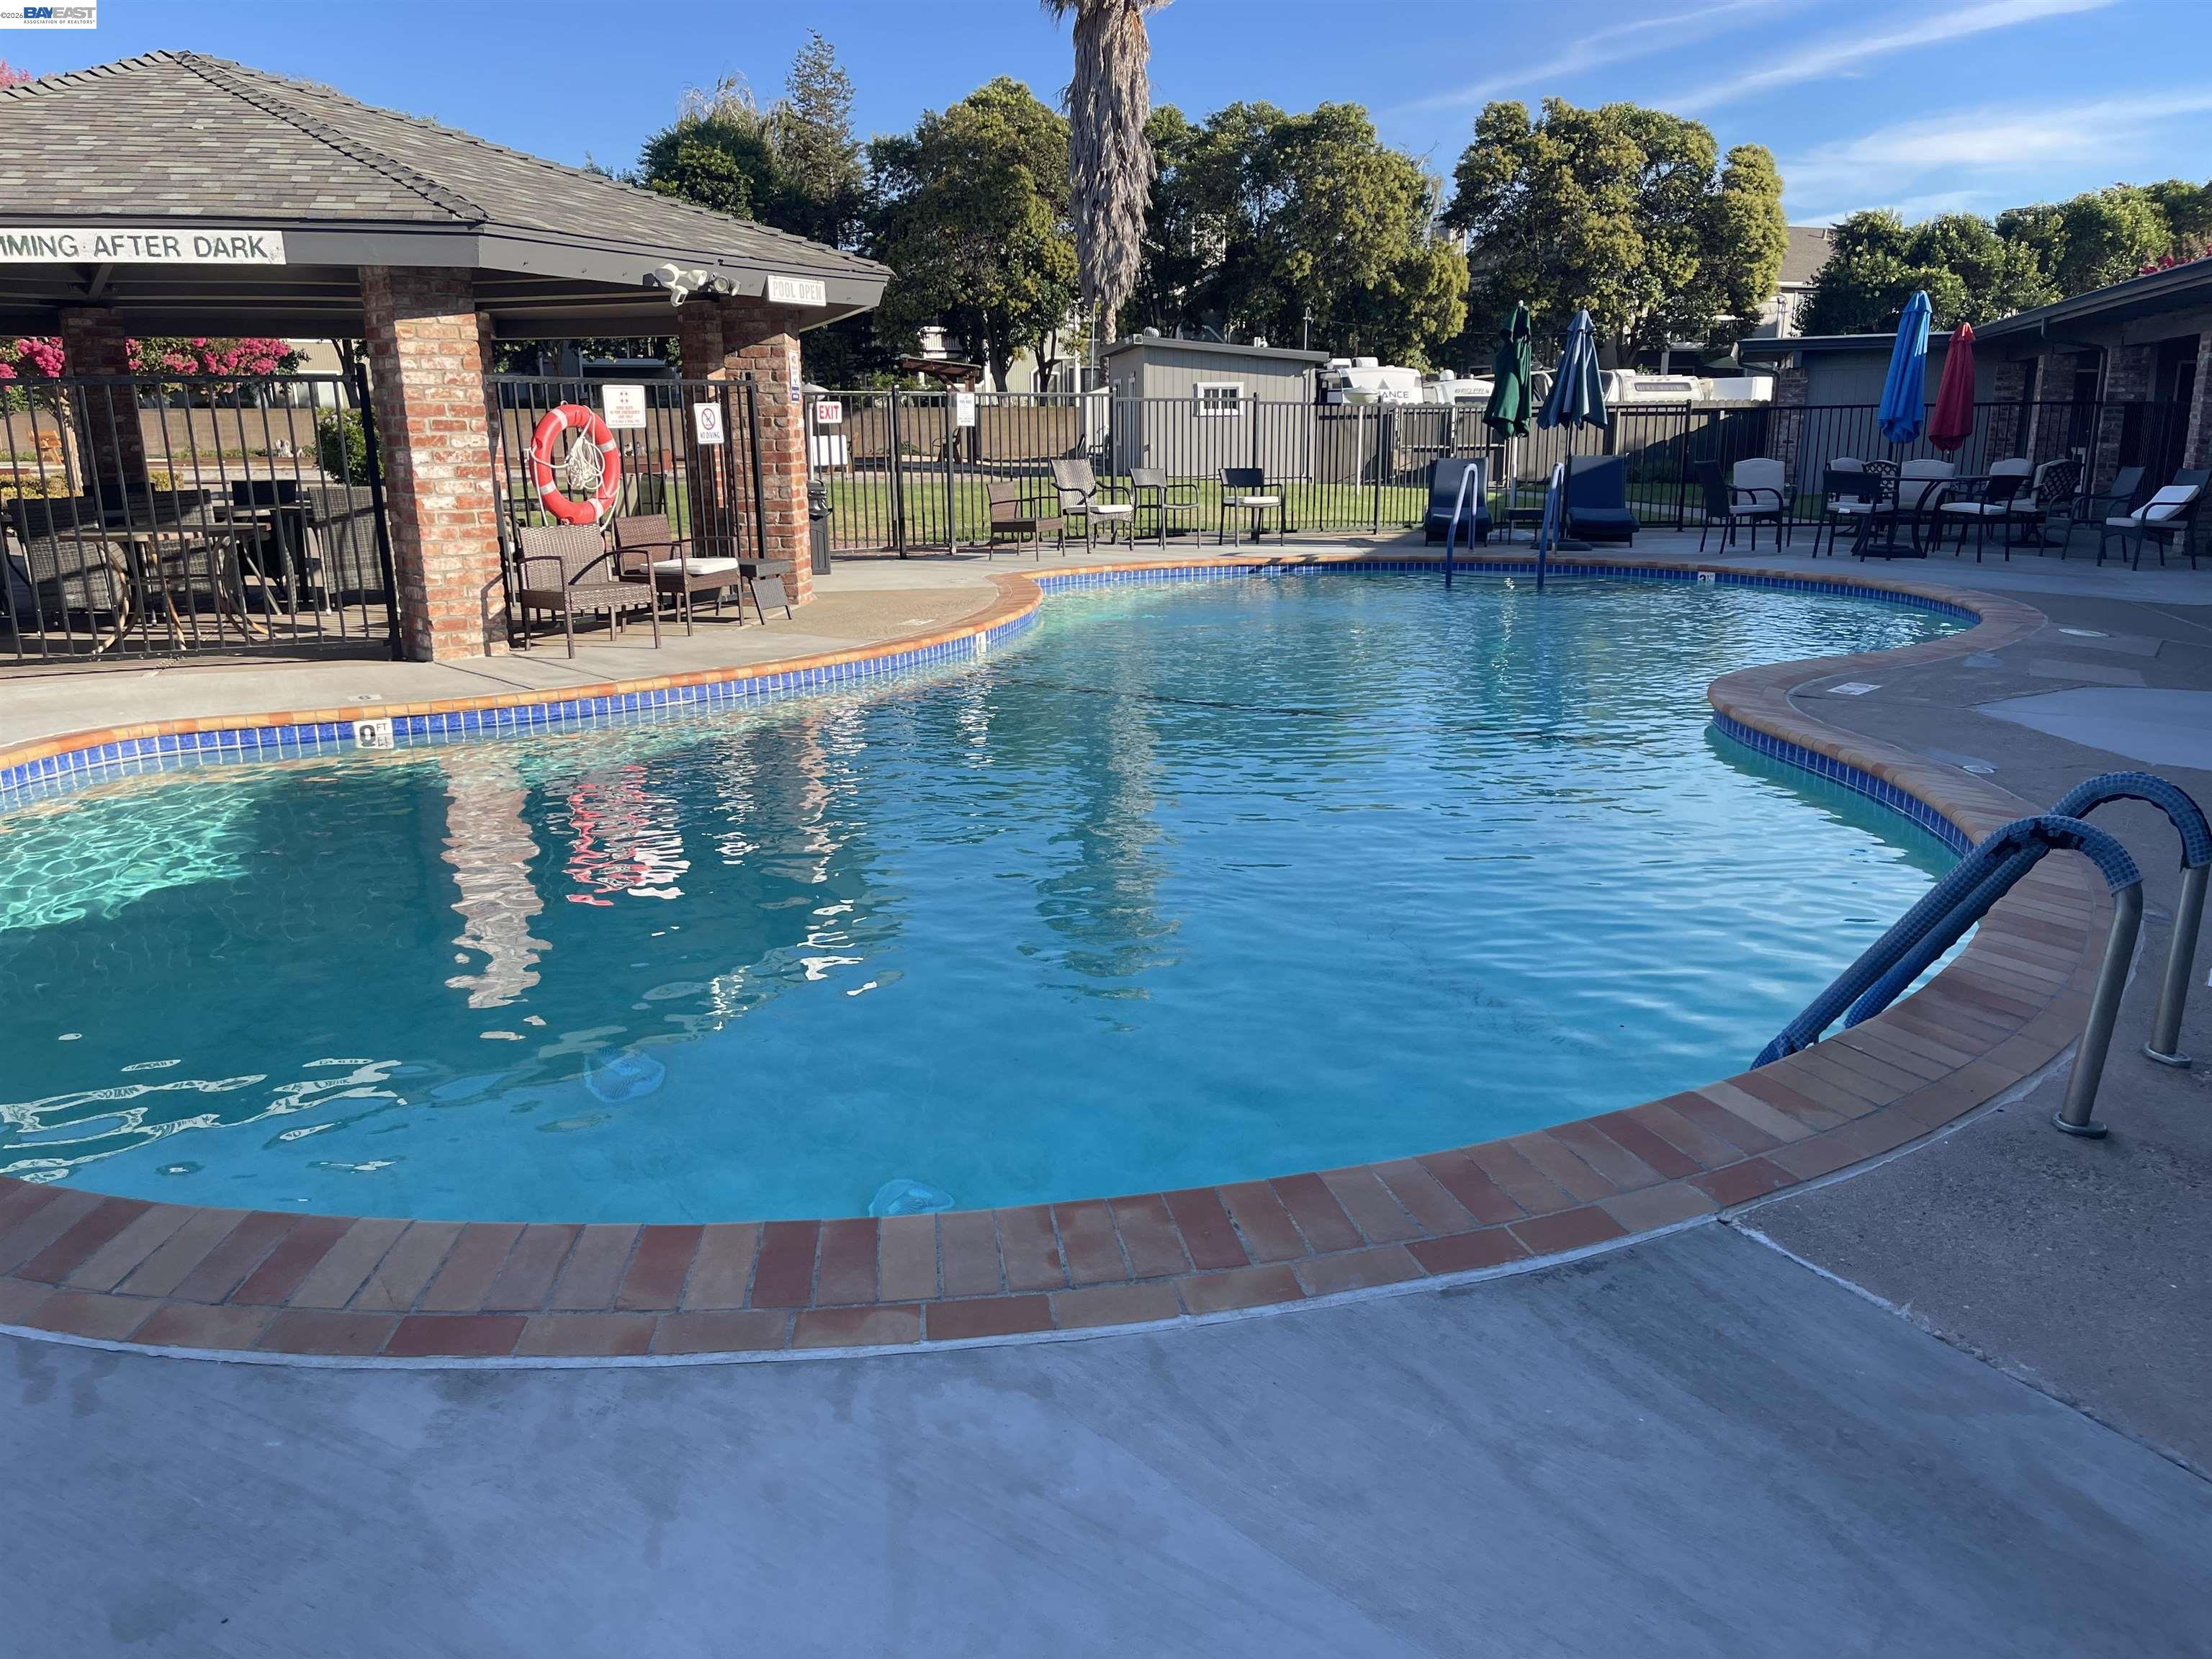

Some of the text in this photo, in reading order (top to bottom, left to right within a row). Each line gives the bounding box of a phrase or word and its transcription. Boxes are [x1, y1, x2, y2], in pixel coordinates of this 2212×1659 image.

[94, 235, 182, 257] AFTER
[194, 235, 268, 258] DARK
[773, 281, 822, 300] POOL OPEN
[819, 405, 840, 420] EXIT
